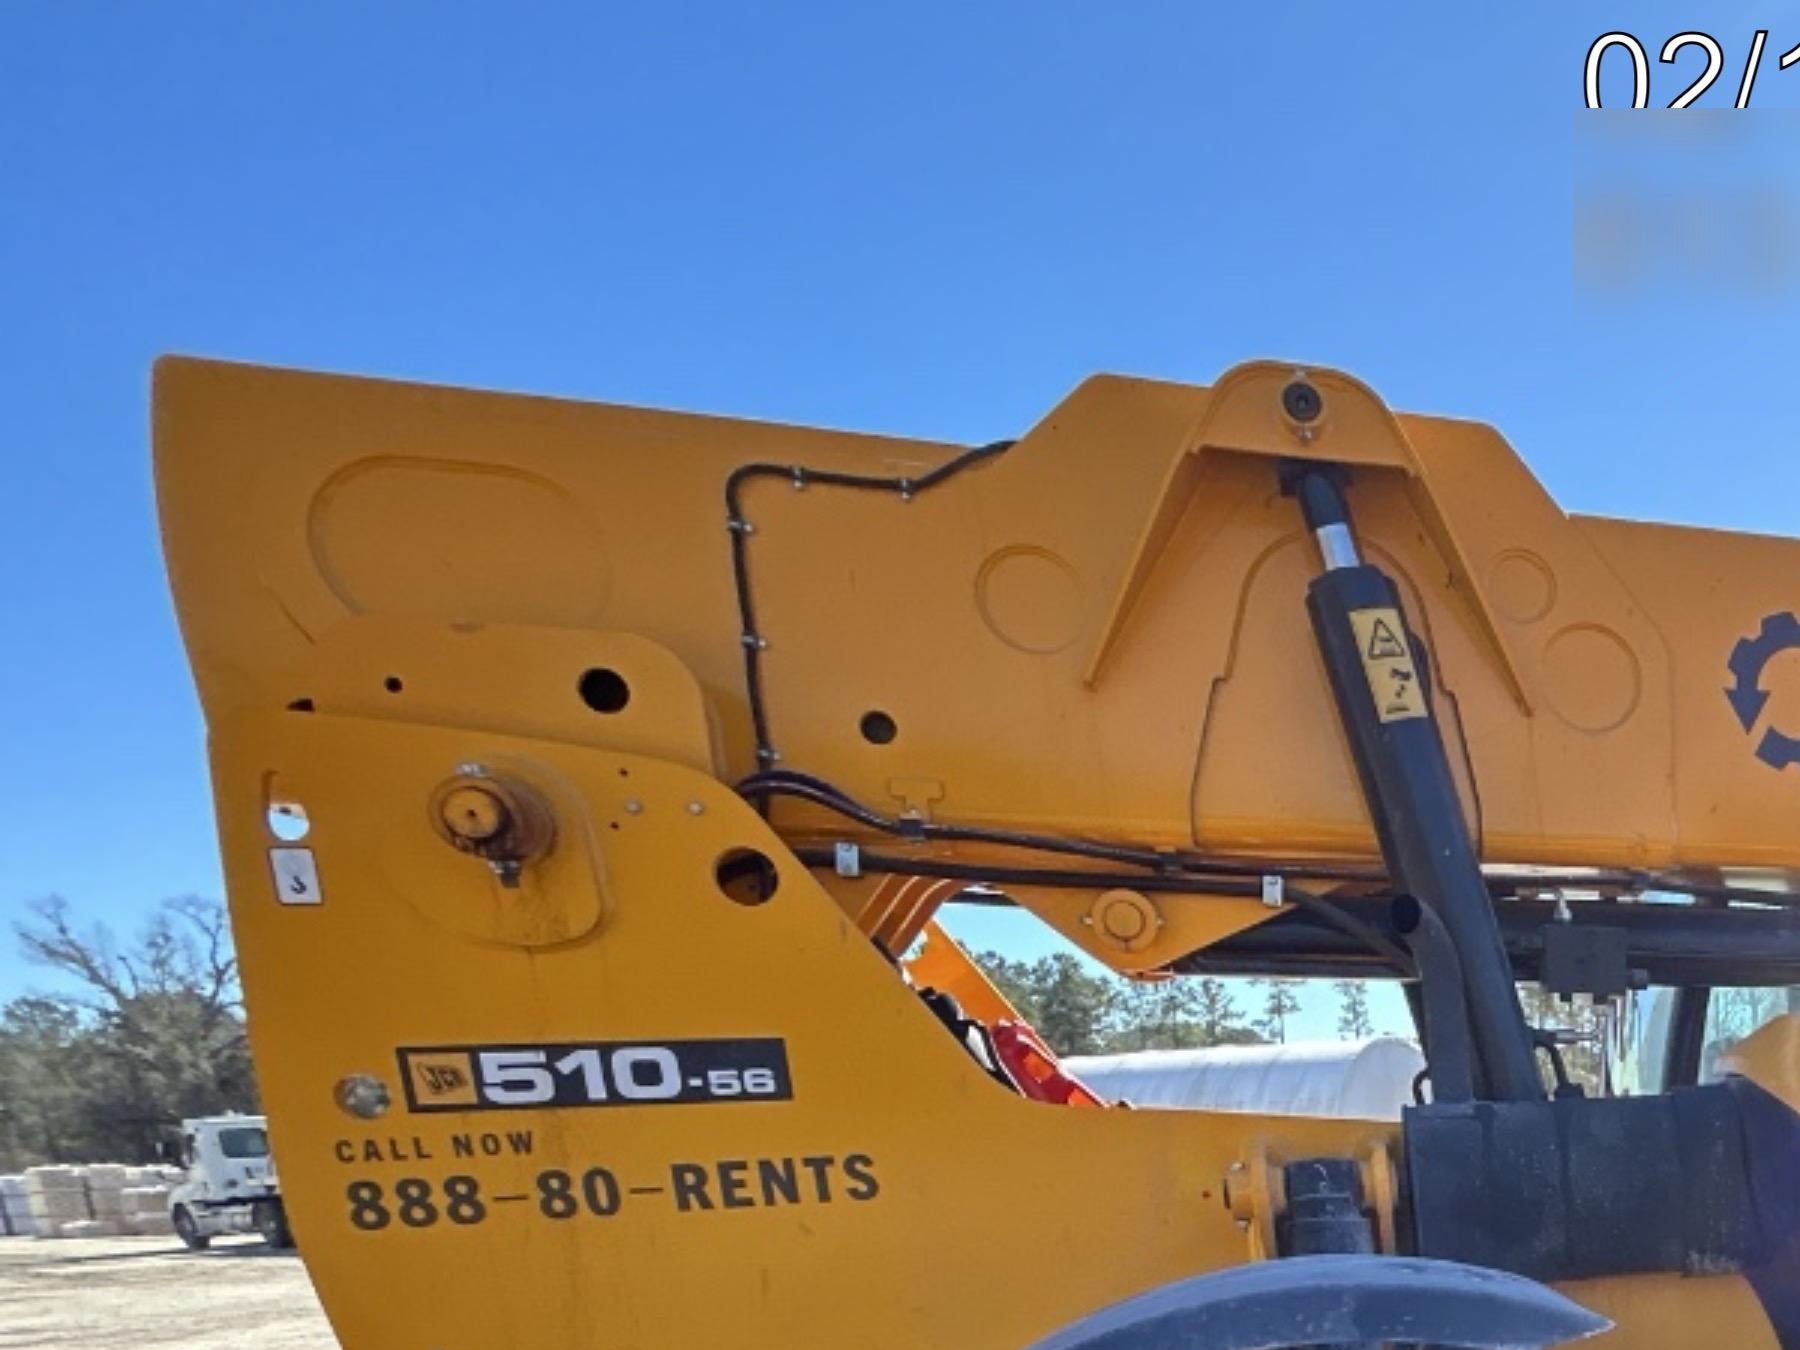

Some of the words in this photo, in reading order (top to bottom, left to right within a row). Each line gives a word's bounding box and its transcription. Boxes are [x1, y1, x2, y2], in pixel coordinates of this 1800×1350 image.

[478, 1046, 776, 1105] 510-56
[335, 1136, 432, 1163] CALL
[452, 1131, 534, 1156] NOW
[346, 1153, 881, 1231] 888-80-RENTS
